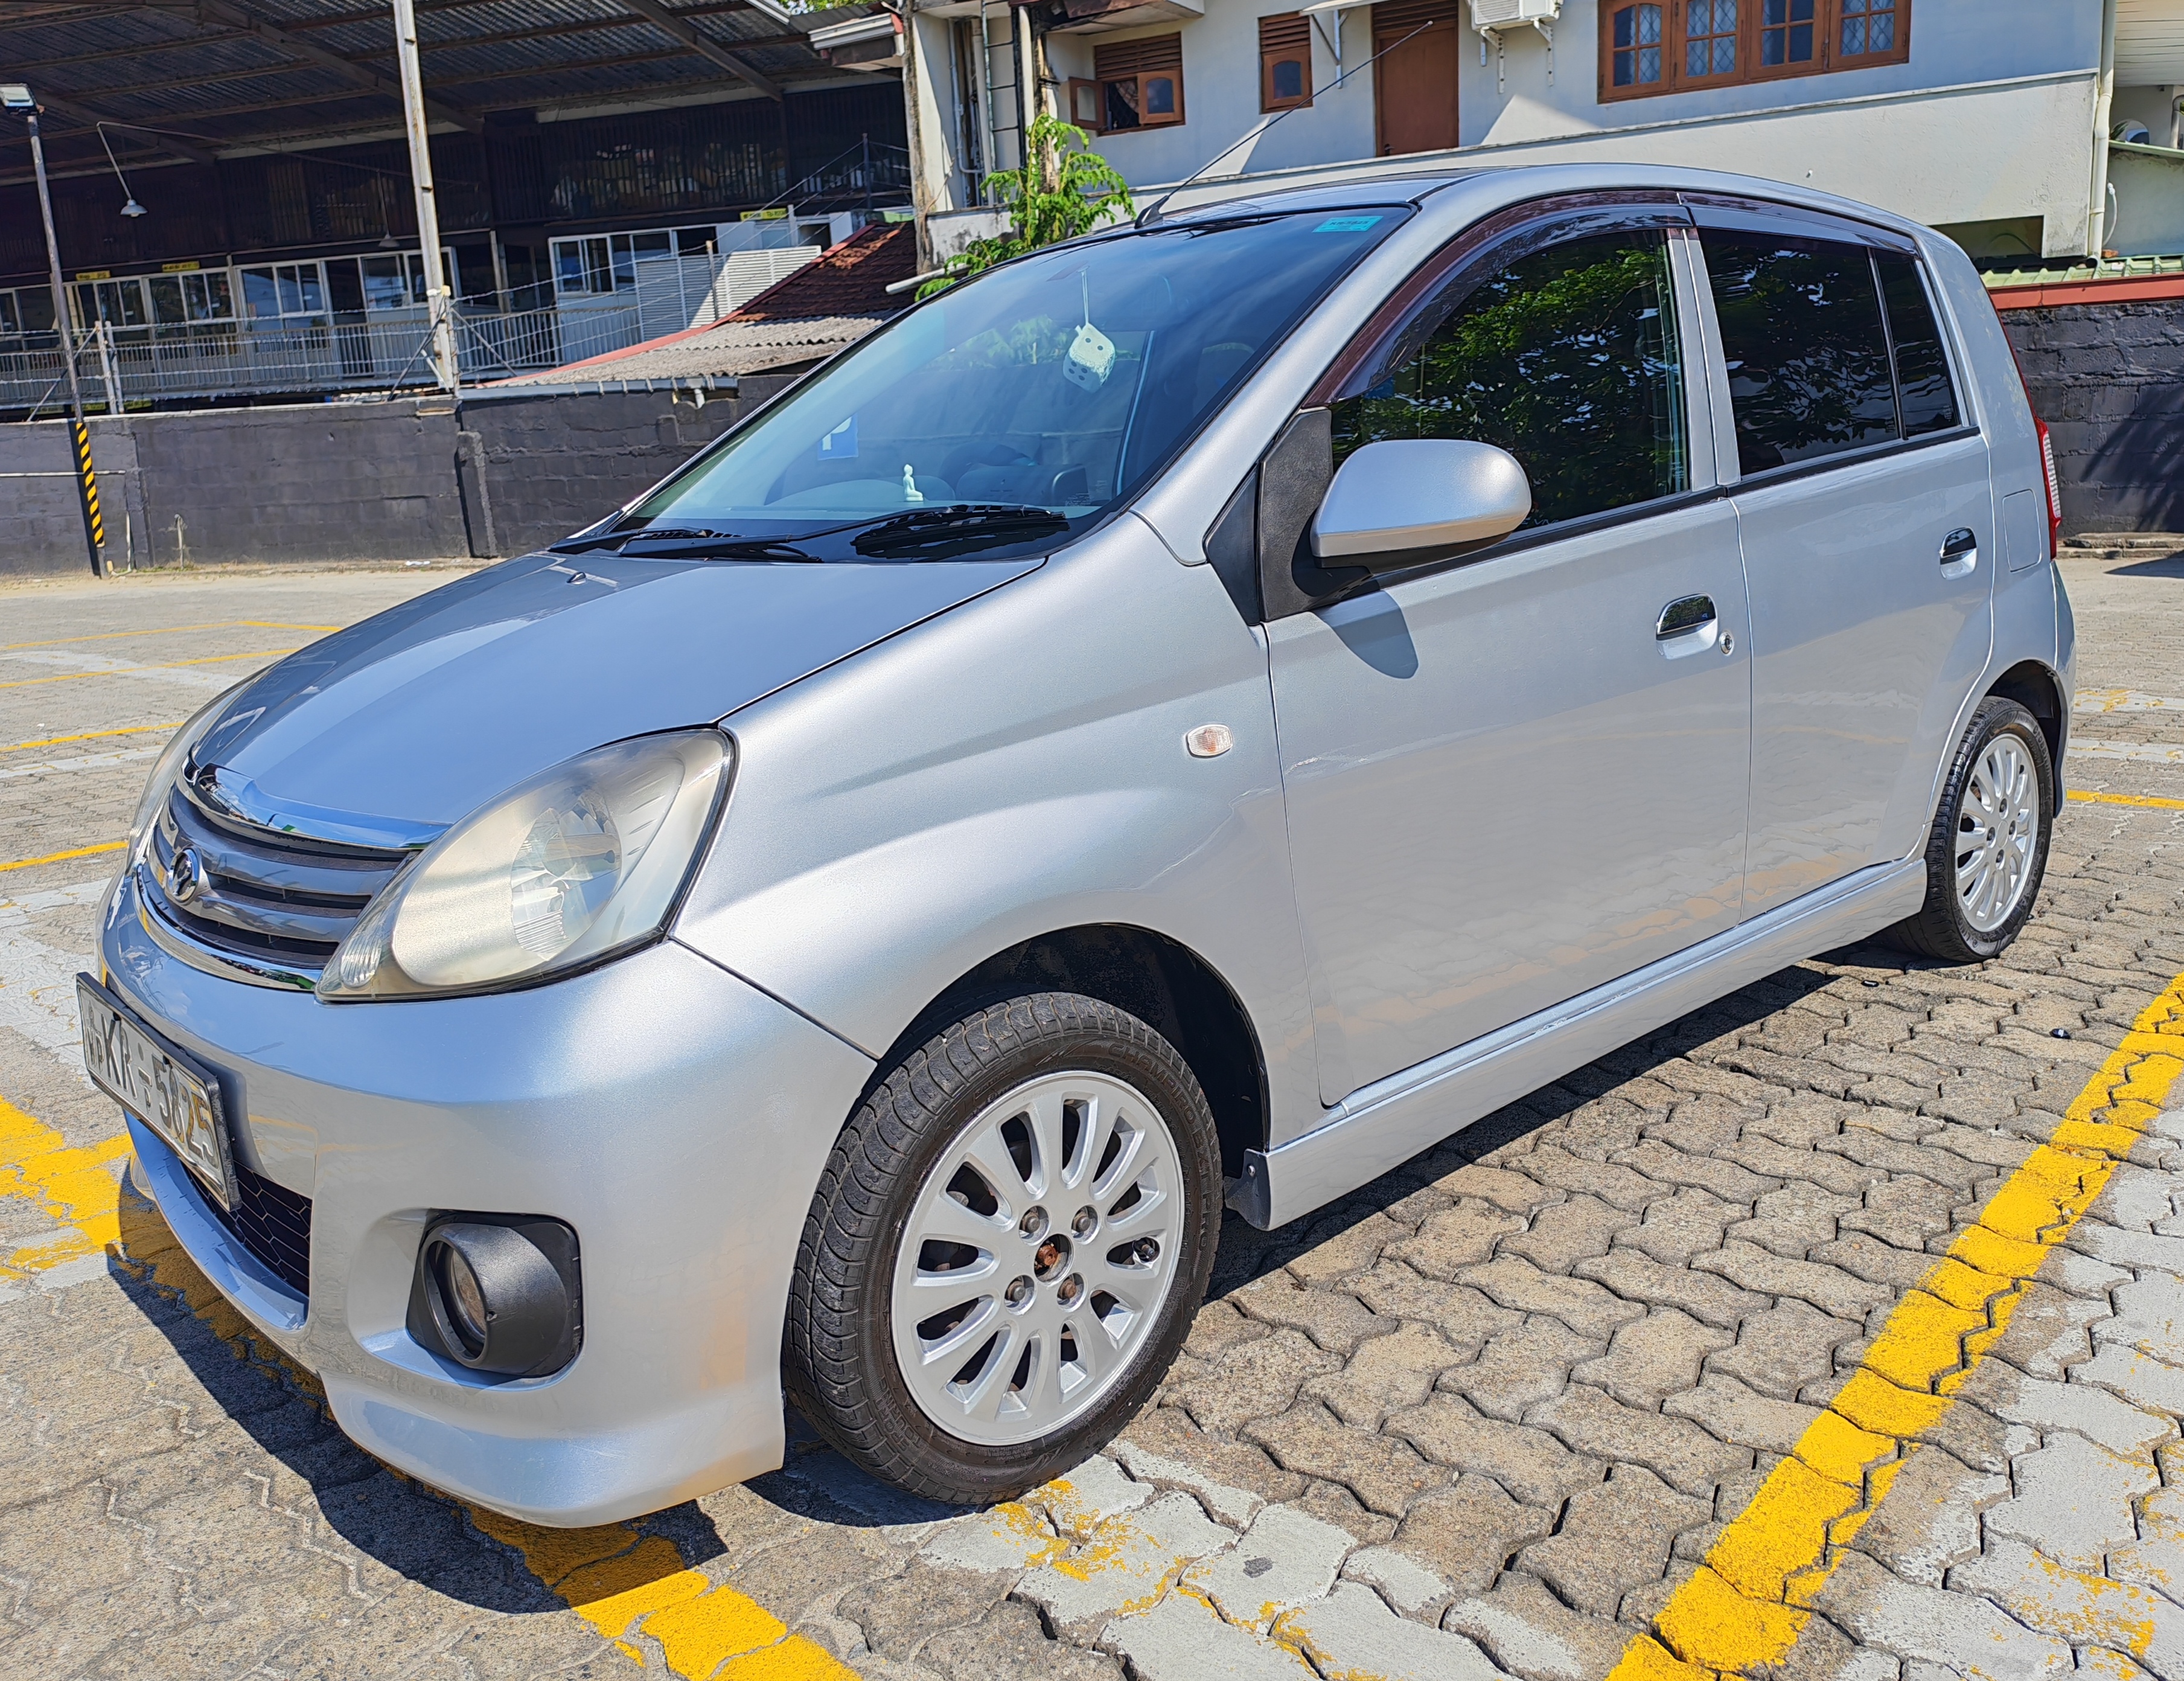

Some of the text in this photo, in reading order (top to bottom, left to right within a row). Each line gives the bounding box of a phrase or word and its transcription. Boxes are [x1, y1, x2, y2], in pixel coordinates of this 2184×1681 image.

[1108, 1042, 1197, 1125] CHAMPIRO
[1198, 1191, 1212, 1252] PRO
[878, 1375, 922, 1448] TOURING
